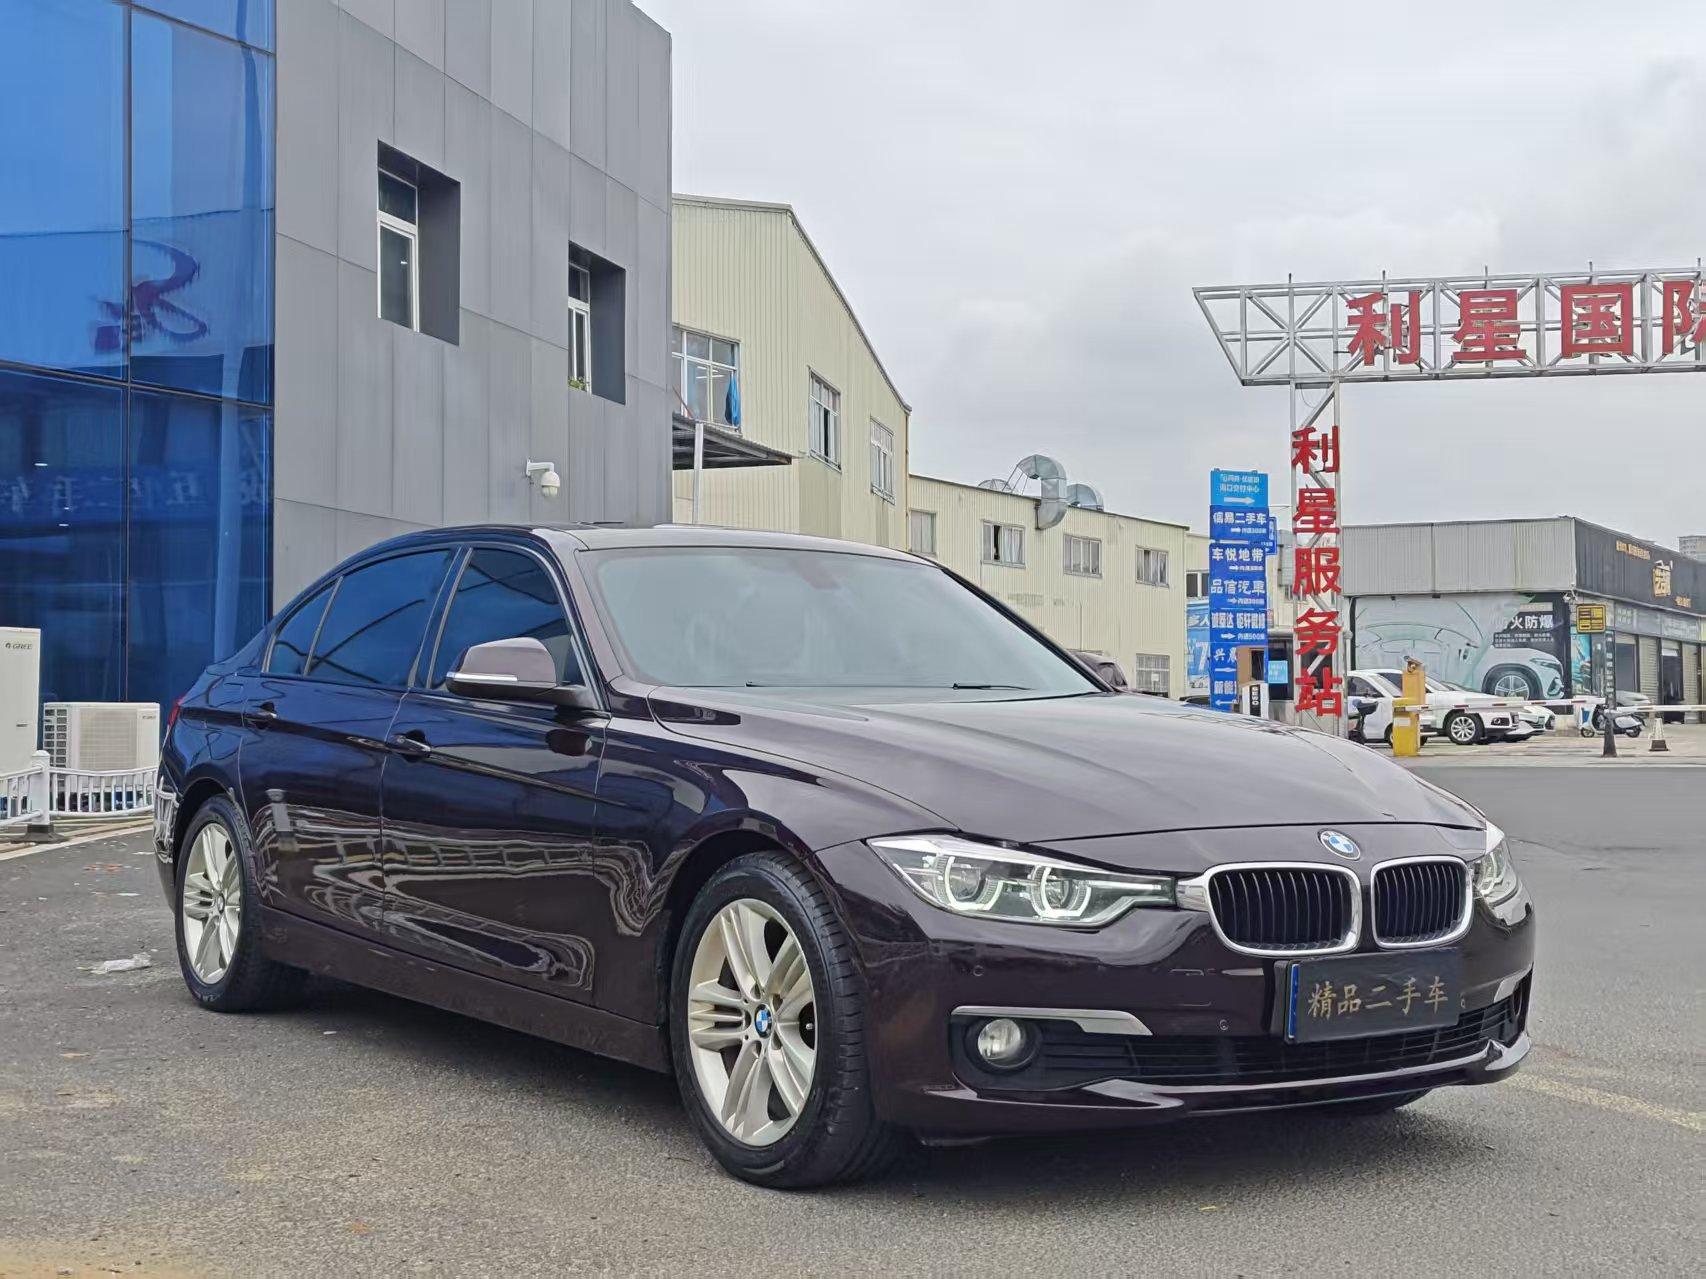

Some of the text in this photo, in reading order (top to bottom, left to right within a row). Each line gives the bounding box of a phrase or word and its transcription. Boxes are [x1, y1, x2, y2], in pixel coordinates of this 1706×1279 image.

[1211, 547, 1264, 562] 车悦地带
[1292, 425, 1342, 717] 利星服务站
[1214, 680, 1237, 695] 新能
[1308, 976, 1448, 1019] 精品二手车
